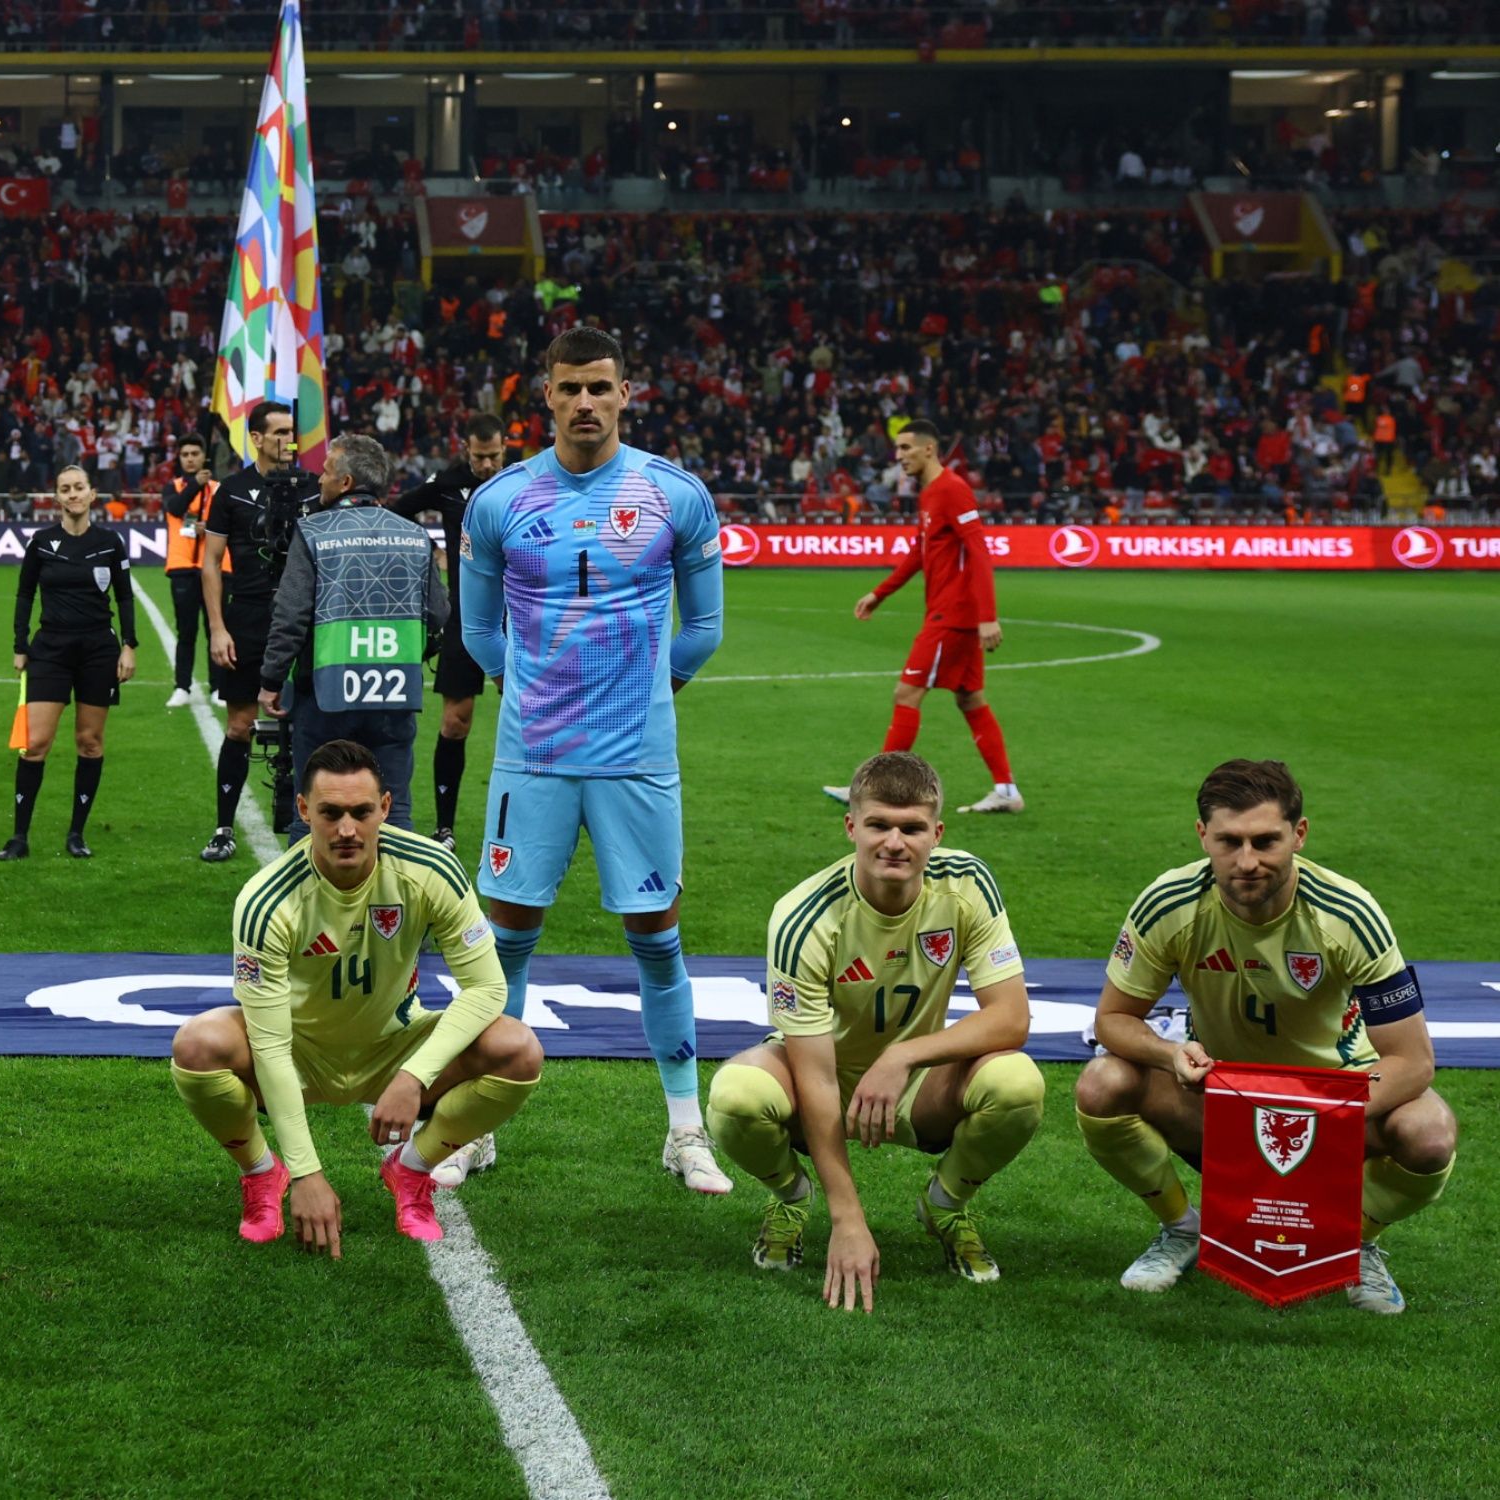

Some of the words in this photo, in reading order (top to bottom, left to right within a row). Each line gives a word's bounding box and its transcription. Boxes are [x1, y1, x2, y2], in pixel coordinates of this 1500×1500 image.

[316, 540, 343, 551] UEFA
[343, 536, 388, 547] NATIONS
[388, 536, 426, 548] LEAGUE
[767, 535, 884, 555] TURKISH
[1106, 536, 1225, 557] TURKISH
[1231, 537, 1353, 557] AIRLINES
[1450, 537, 1500, 557] TUR
[578, 549, 588, 597] 1
[350, 626, 399, 658] HB
[343, 668, 407, 703] 022
[497, 792, 509, 839] 1
[331, 954, 373, 1000] 14
[874, 984, 921, 1034] 17
[1245, 994, 1277, 1037] 4
